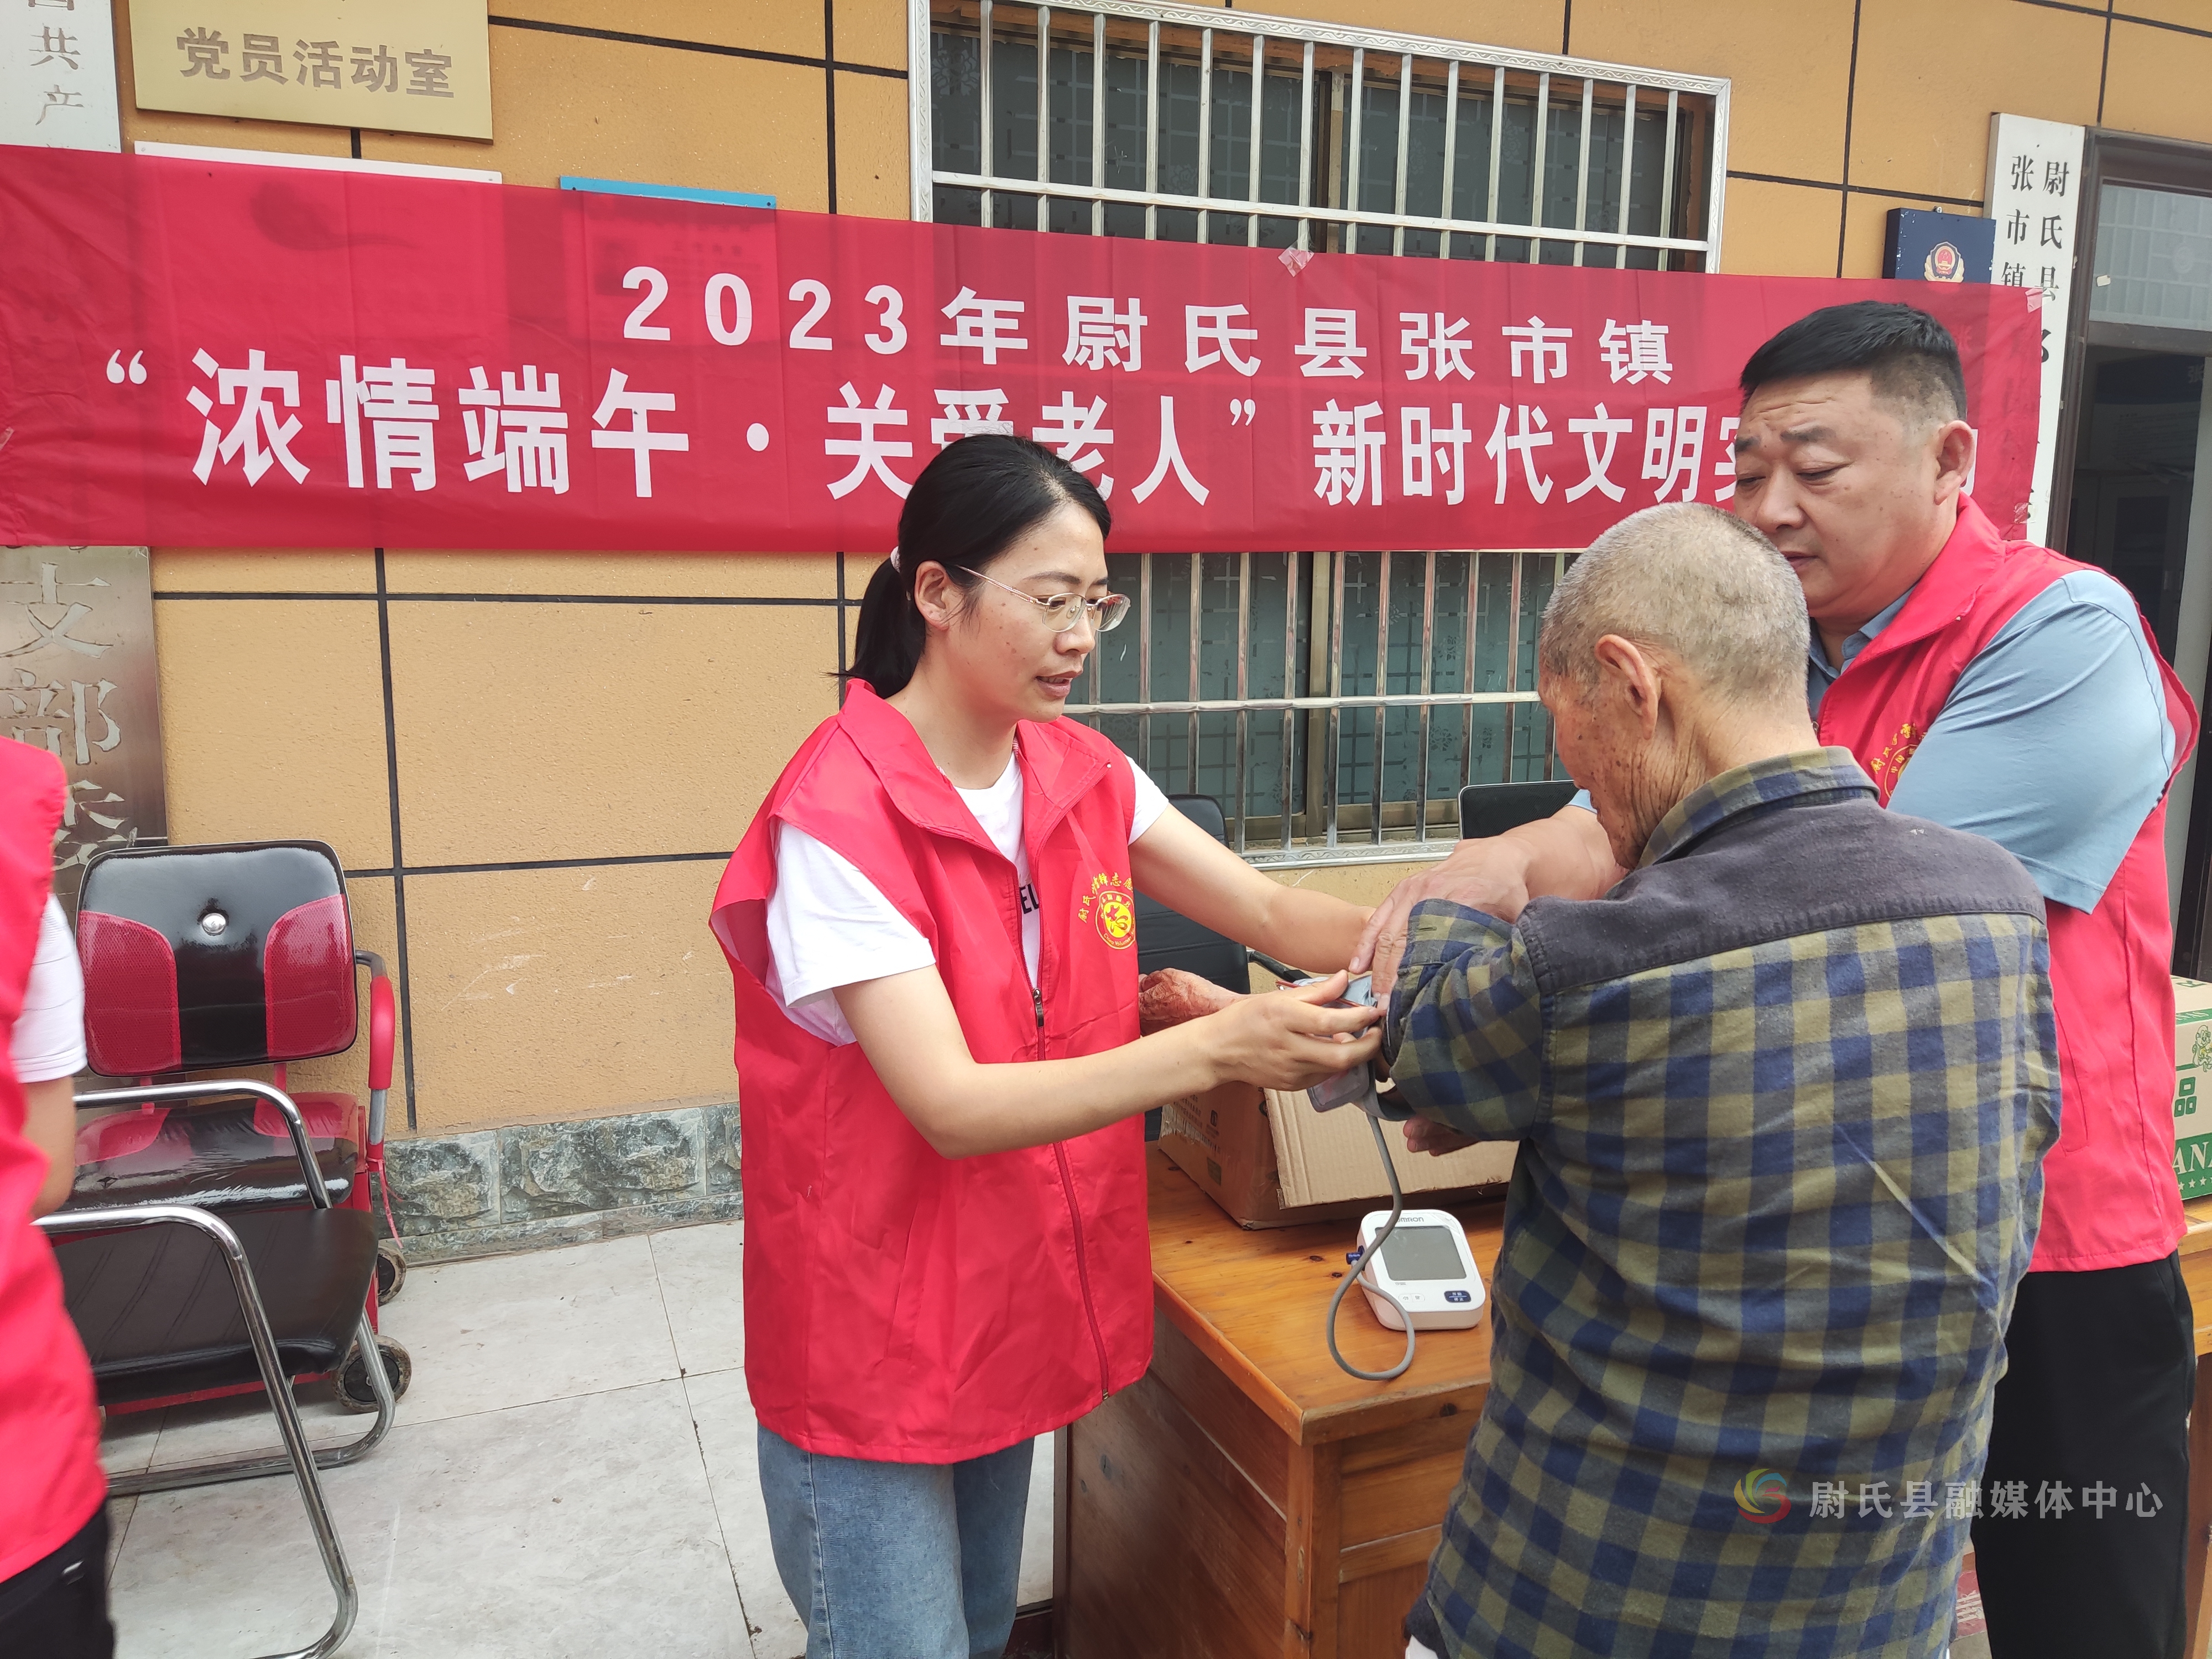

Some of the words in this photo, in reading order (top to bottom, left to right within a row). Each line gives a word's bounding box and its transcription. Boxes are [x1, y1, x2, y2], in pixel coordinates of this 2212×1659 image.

[176, 27, 455, 99] 党员活动室
[2000, 154, 2034, 287] 张市镇
[2035, 160, 2070, 301] 尉氏县
[622, 265, 1673, 385] 2023年尉氏县张市镇
[2173, 1141, 2212, 1175] AN
